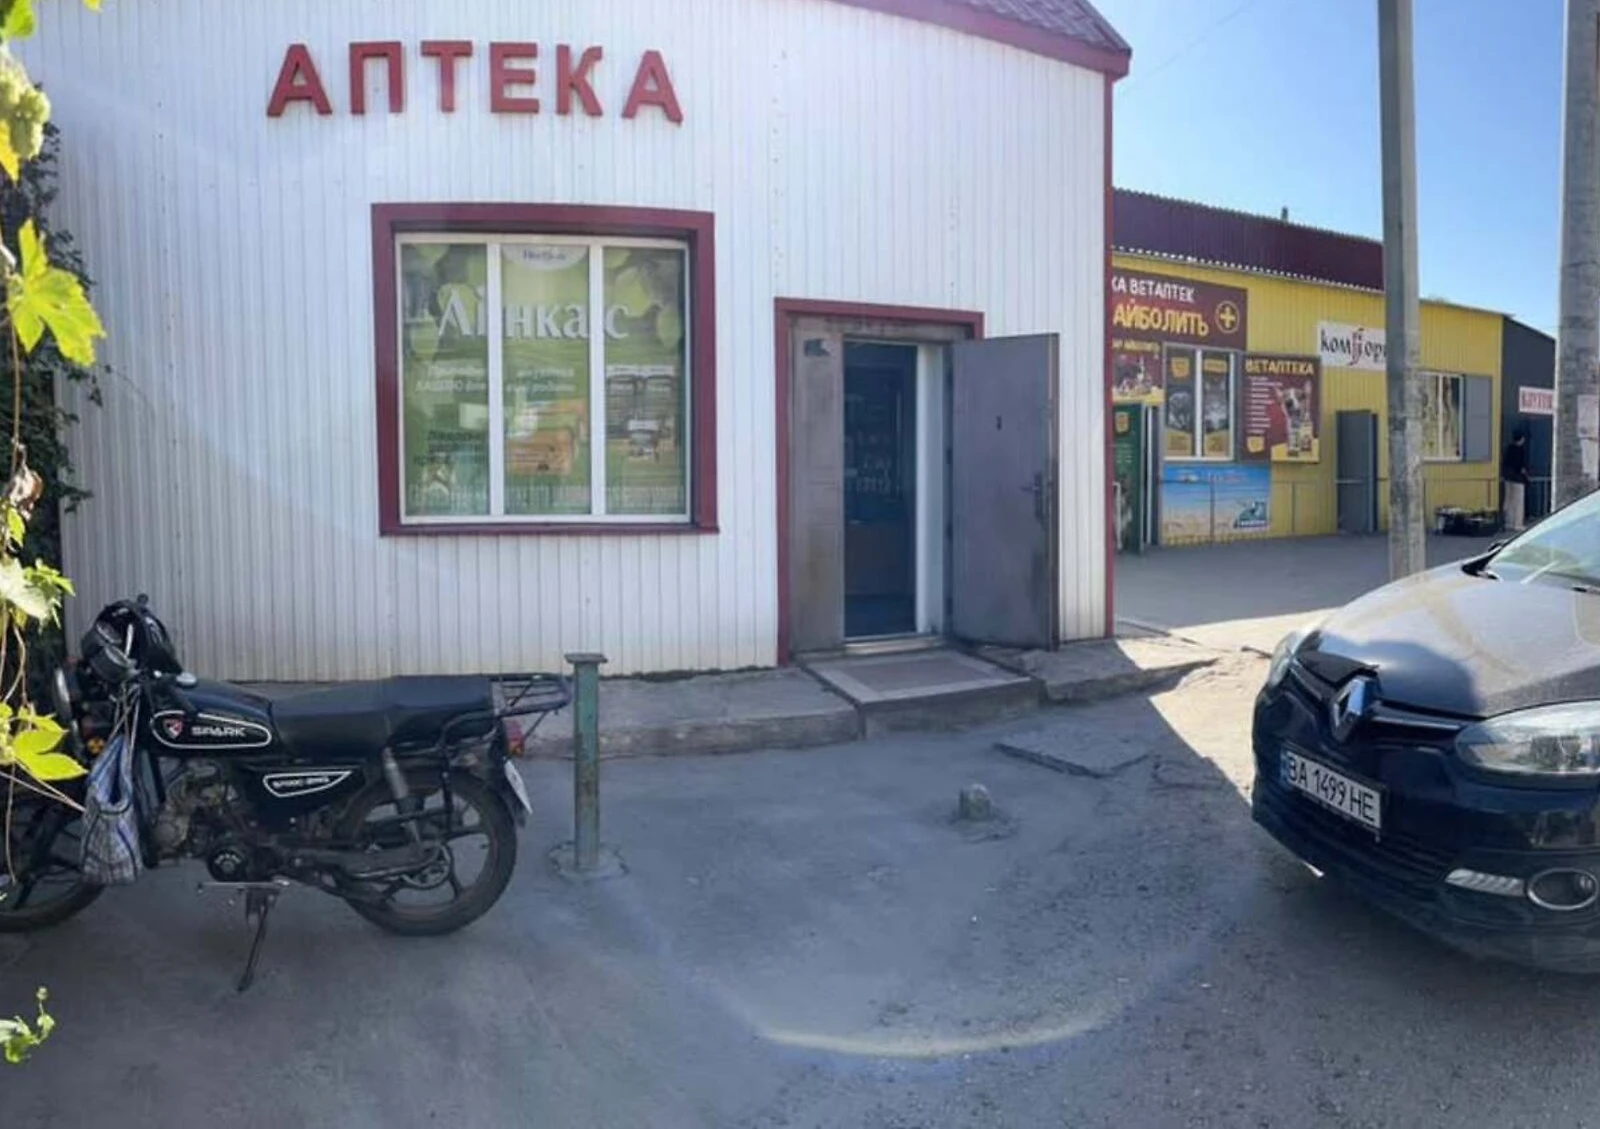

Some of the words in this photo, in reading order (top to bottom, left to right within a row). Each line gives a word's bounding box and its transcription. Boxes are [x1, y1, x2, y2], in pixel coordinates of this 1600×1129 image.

[267, 41, 683, 125] АПТЕКА
[1129, 278, 1195, 303] ВЕТАПТЕК
[1113, 298, 1209, 337] АЙБОЛИТЬ
[1245, 358, 1315, 376] ВЕТАПТЕКА
[191, 726, 246, 737] SPARK
[1288, 756, 1308, 789] BA
[1313, 768, 1346, 806] 1499
[1349, 786, 1375, 822] HE
